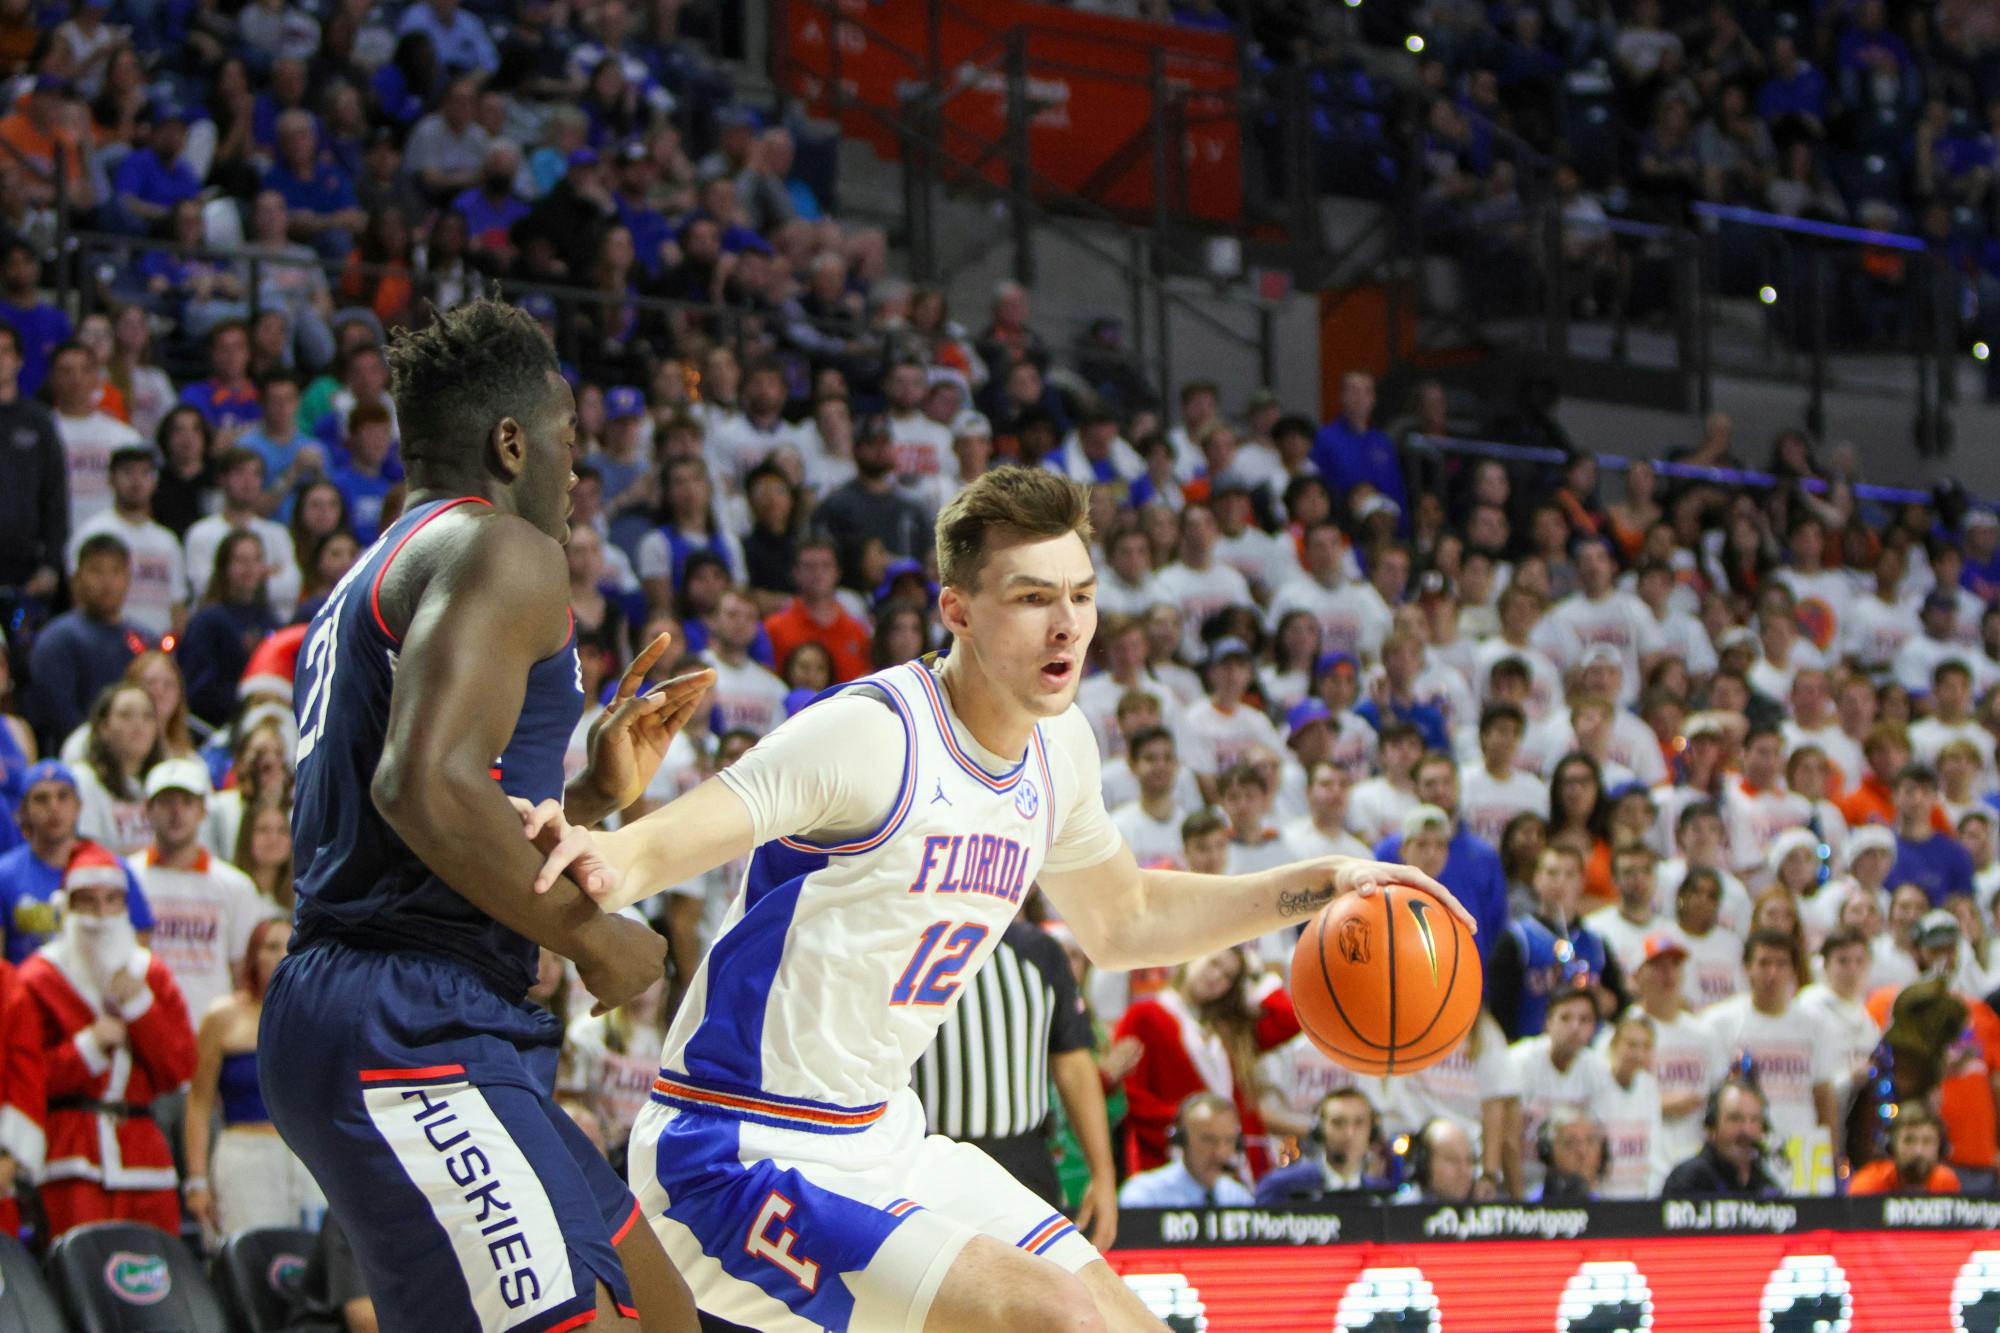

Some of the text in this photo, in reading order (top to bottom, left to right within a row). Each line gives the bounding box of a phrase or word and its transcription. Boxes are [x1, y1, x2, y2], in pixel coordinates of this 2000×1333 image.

[296, 592, 348, 770] 21
[908, 833, 1030, 906] FLORIDA
[888, 920, 990, 1006] 12
[401, 1089, 541, 1310] HUSKIES
[744, 1188, 821, 1295] F
[1250, 1211, 1341, 1245] Mortgage
